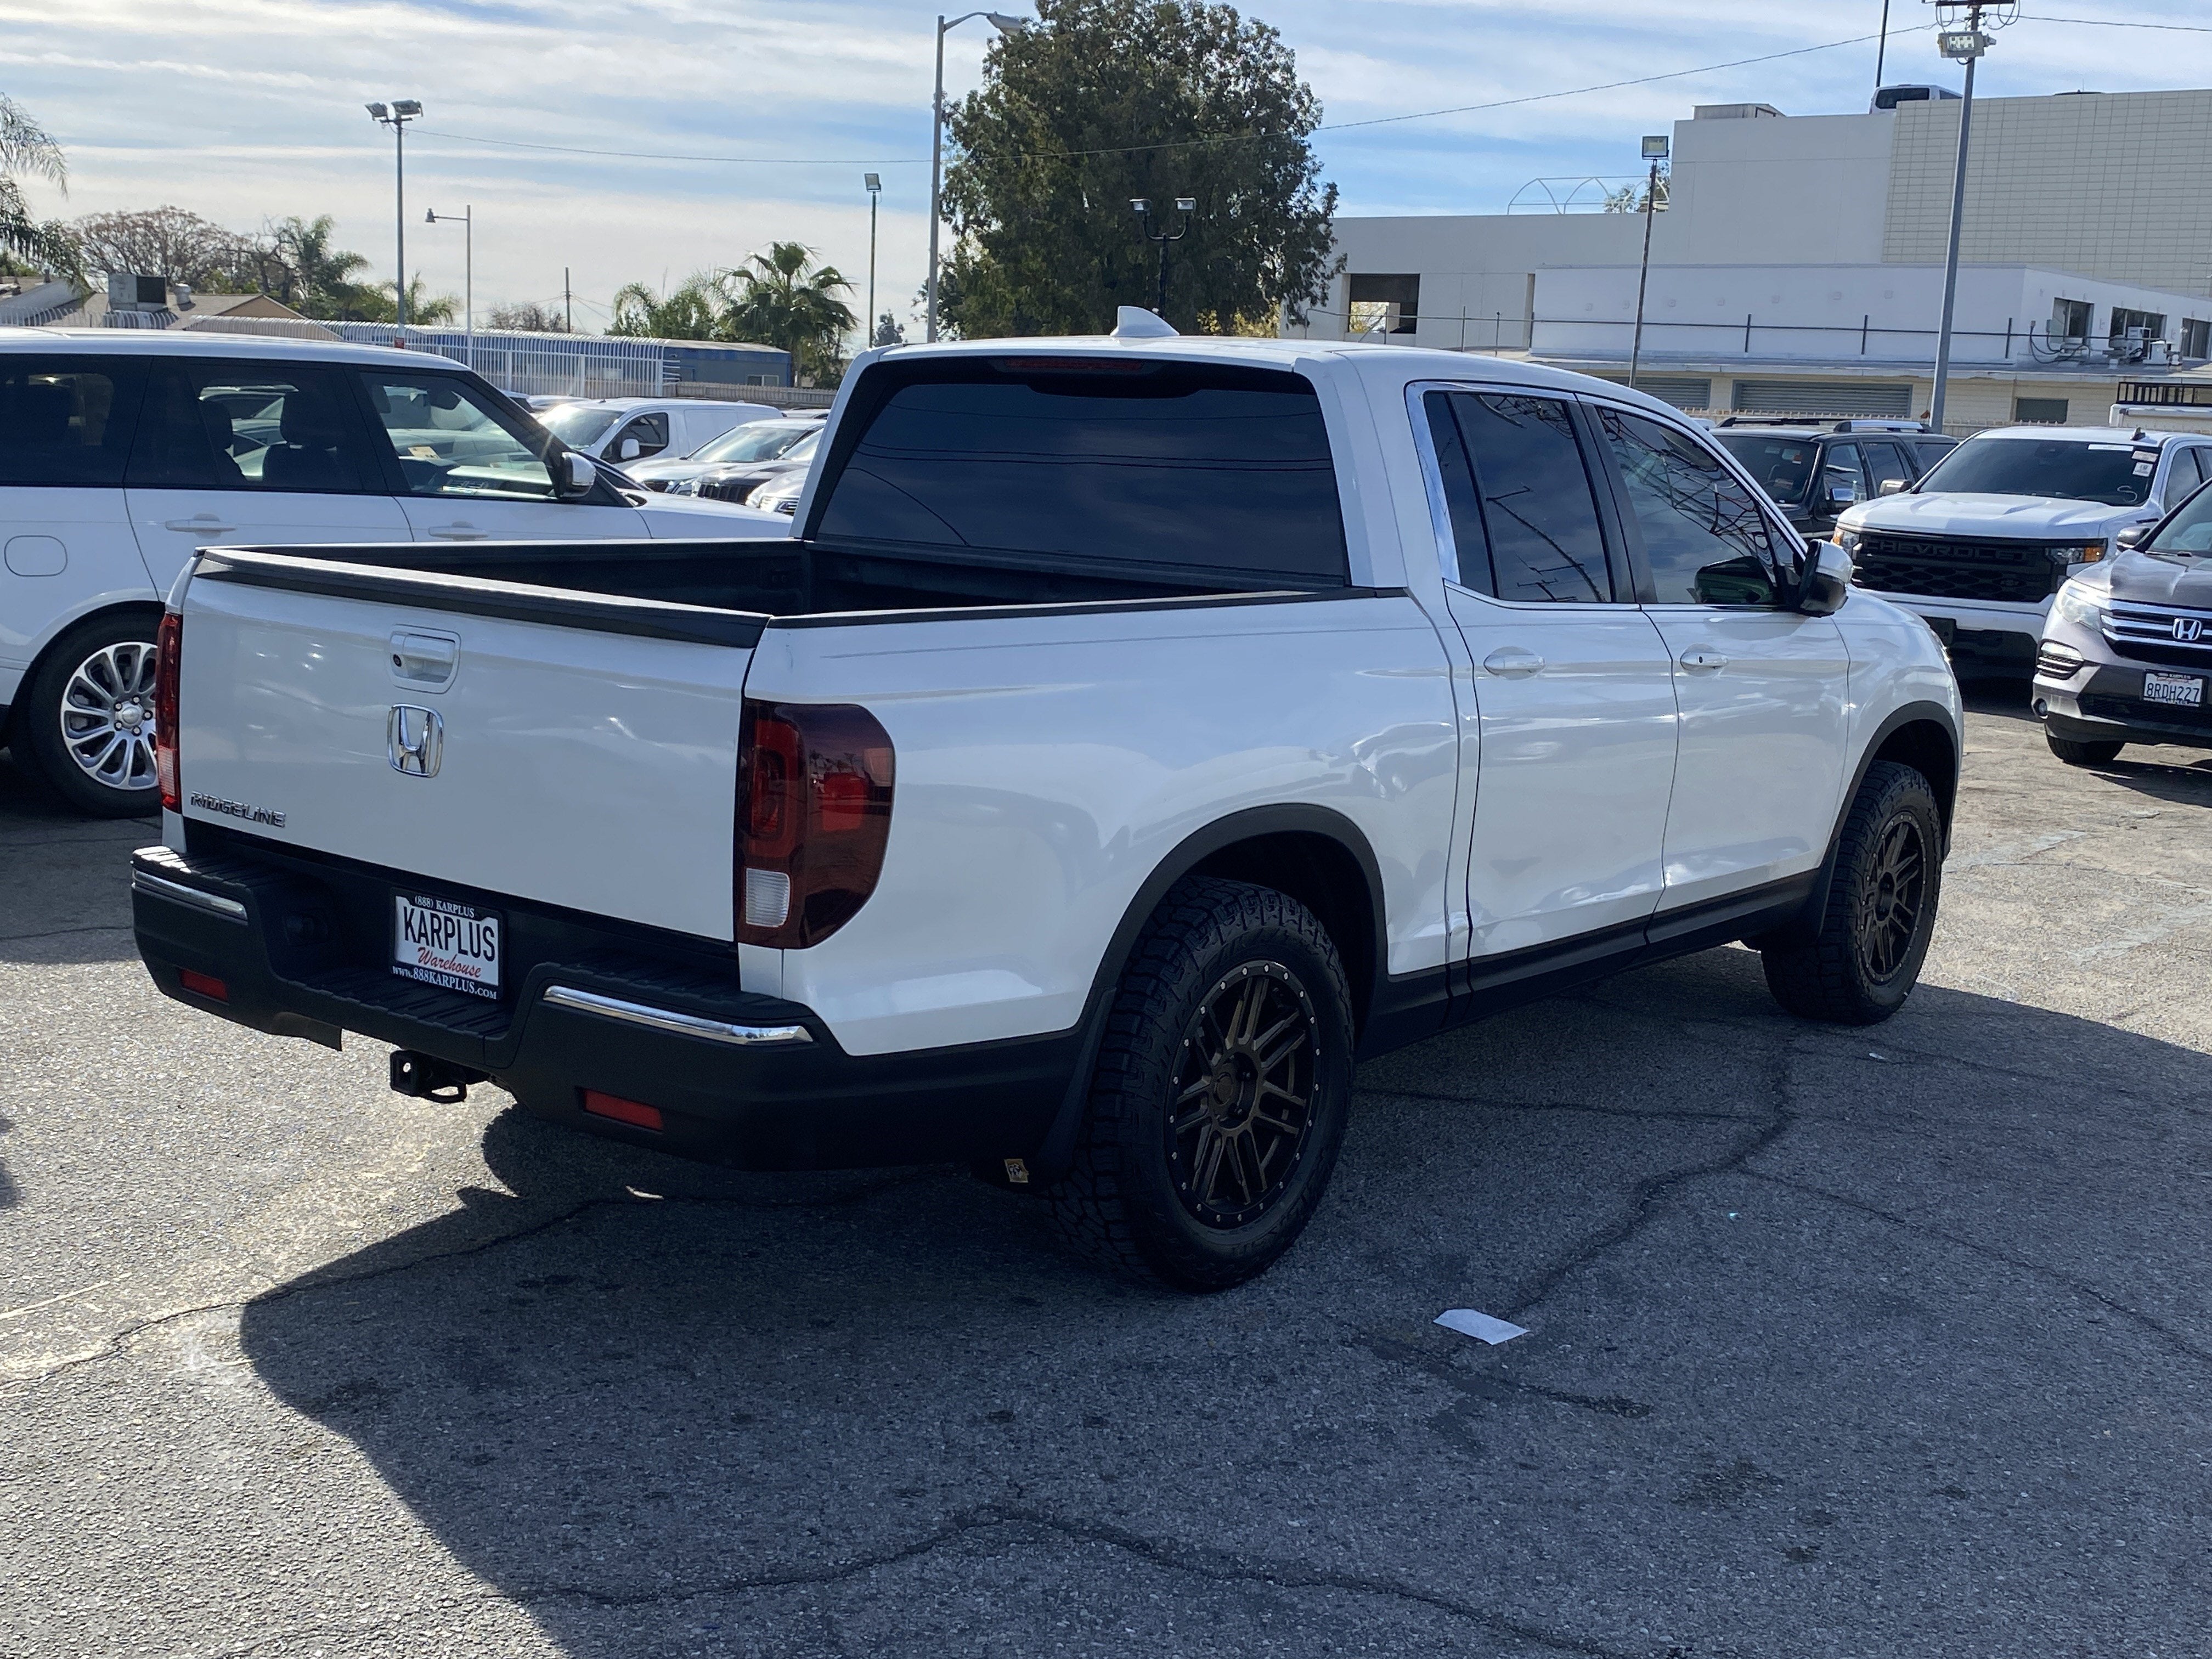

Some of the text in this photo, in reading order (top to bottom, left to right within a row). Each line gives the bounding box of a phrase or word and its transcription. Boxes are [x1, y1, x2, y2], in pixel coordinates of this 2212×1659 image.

[2146, 682, 2200, 703] 8RDH227
[190, 790, 286, 828] RIDGELINE
[414, 895, 475, 918] (888) KARPLUS
[403, 906, 495, 962] KARPLUS
[417, 946, 482, 978] Warehouse
